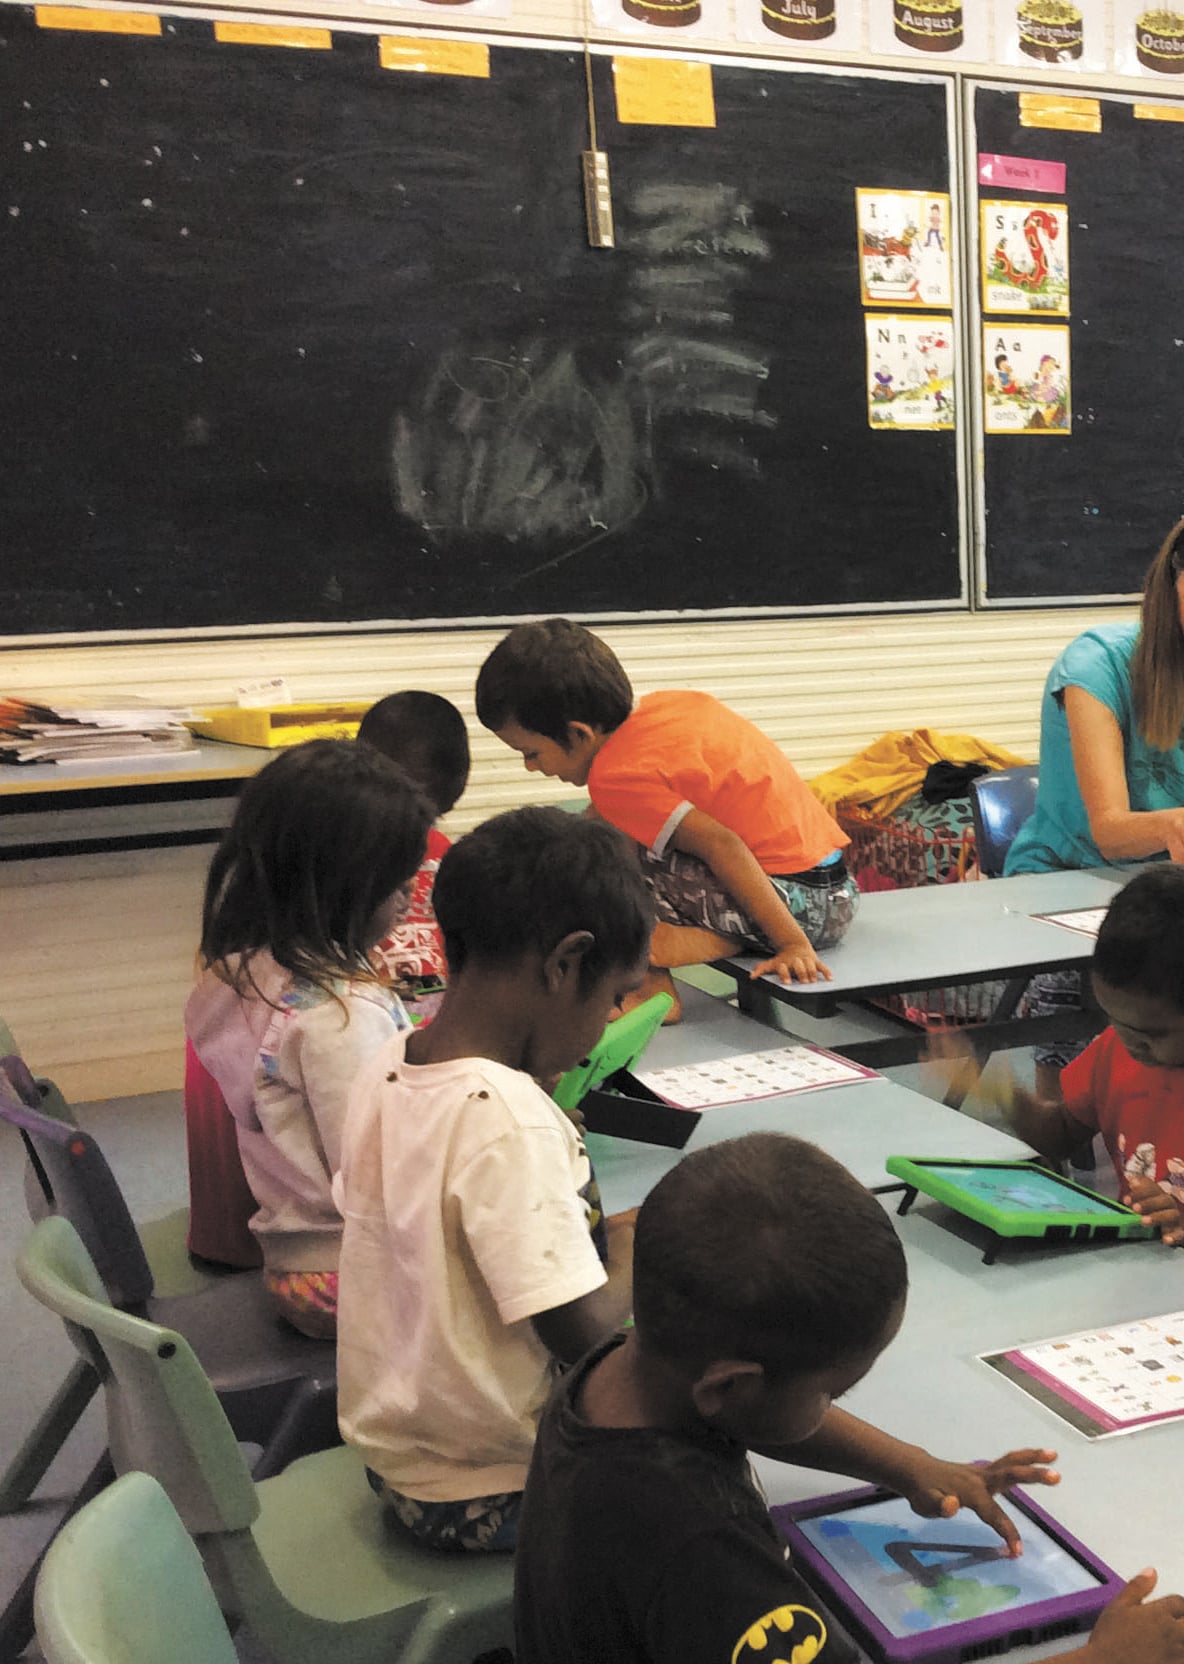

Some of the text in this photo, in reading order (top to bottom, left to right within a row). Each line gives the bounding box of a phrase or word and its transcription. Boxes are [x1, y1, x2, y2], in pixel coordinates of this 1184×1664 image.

[780, 0, 817, 19] July
[902, 10, 954, 31] August
[1017, 17, 1083, 44] September
[995, 214, 1005, 230] S
[877, 328, 907, 344] N n
[995, 337, 1007, 351] A
